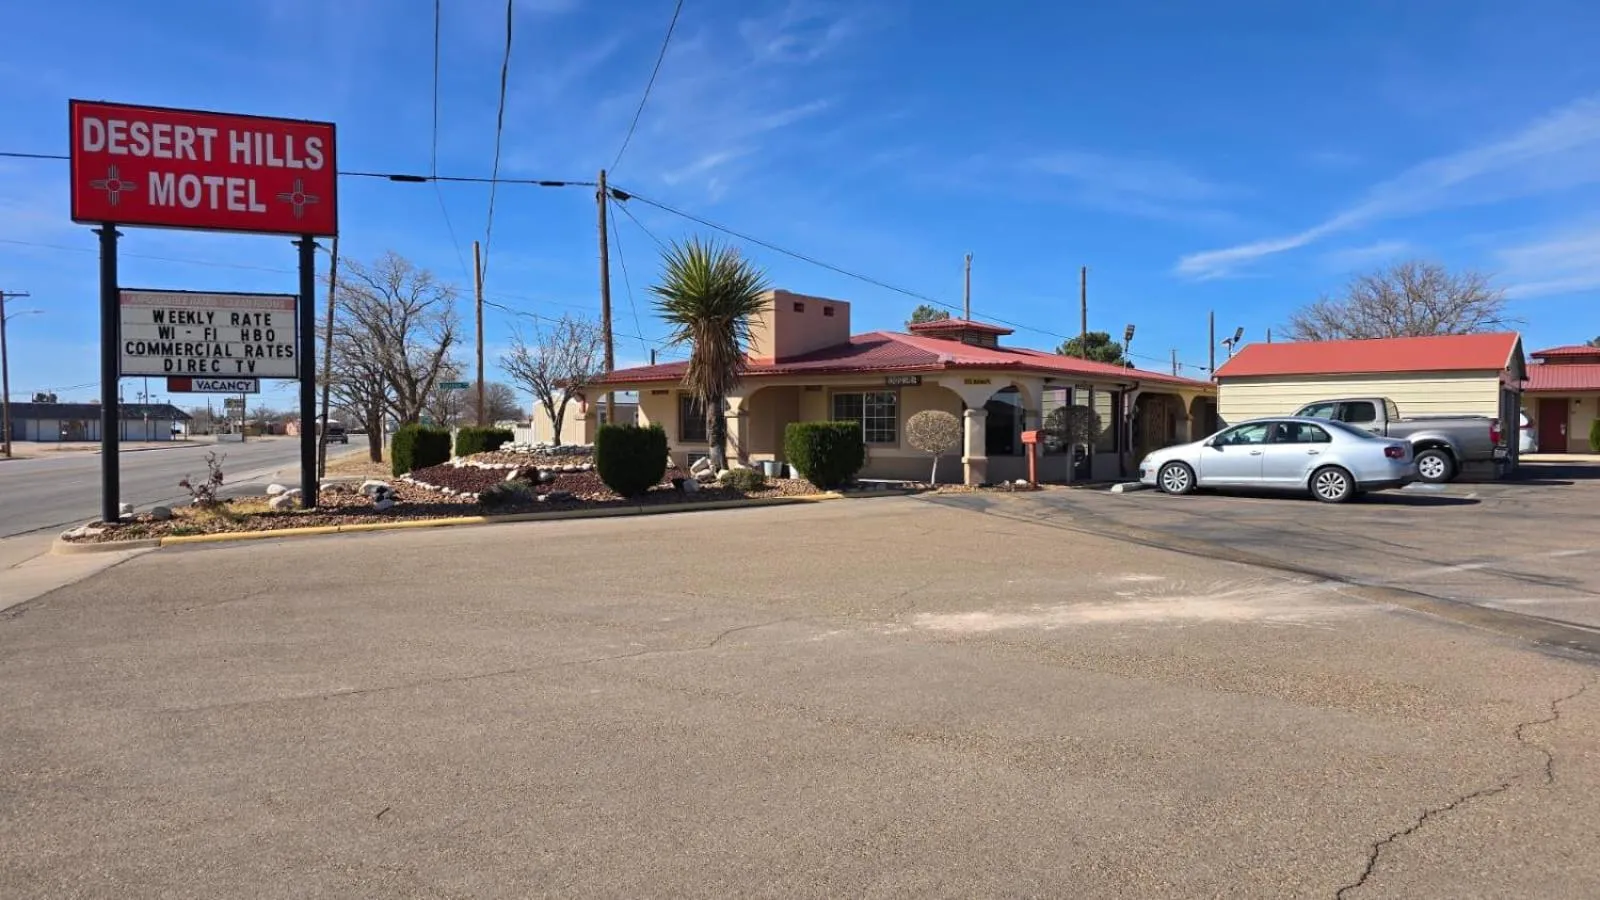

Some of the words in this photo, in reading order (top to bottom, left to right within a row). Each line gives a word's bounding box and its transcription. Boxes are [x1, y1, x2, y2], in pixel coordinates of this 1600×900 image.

[83, 117, 218, 162] DESERT
[229, 130, 324, 170] HILLS
[149, 171, 266, 213] MOTEL
[153, 310, 214, 324] WEEKLY
[231, 313, 271, 326] RATE
[241, 329, 275, 342] HBO
[125, 342, 232, 357] COMMERCIAL
[244, 344, 294, 358] RATES
[163, 358, 221, 372] DIREC
[236, 360, 257, 373] TV
[196, 380, 252, 391] VACANCY
